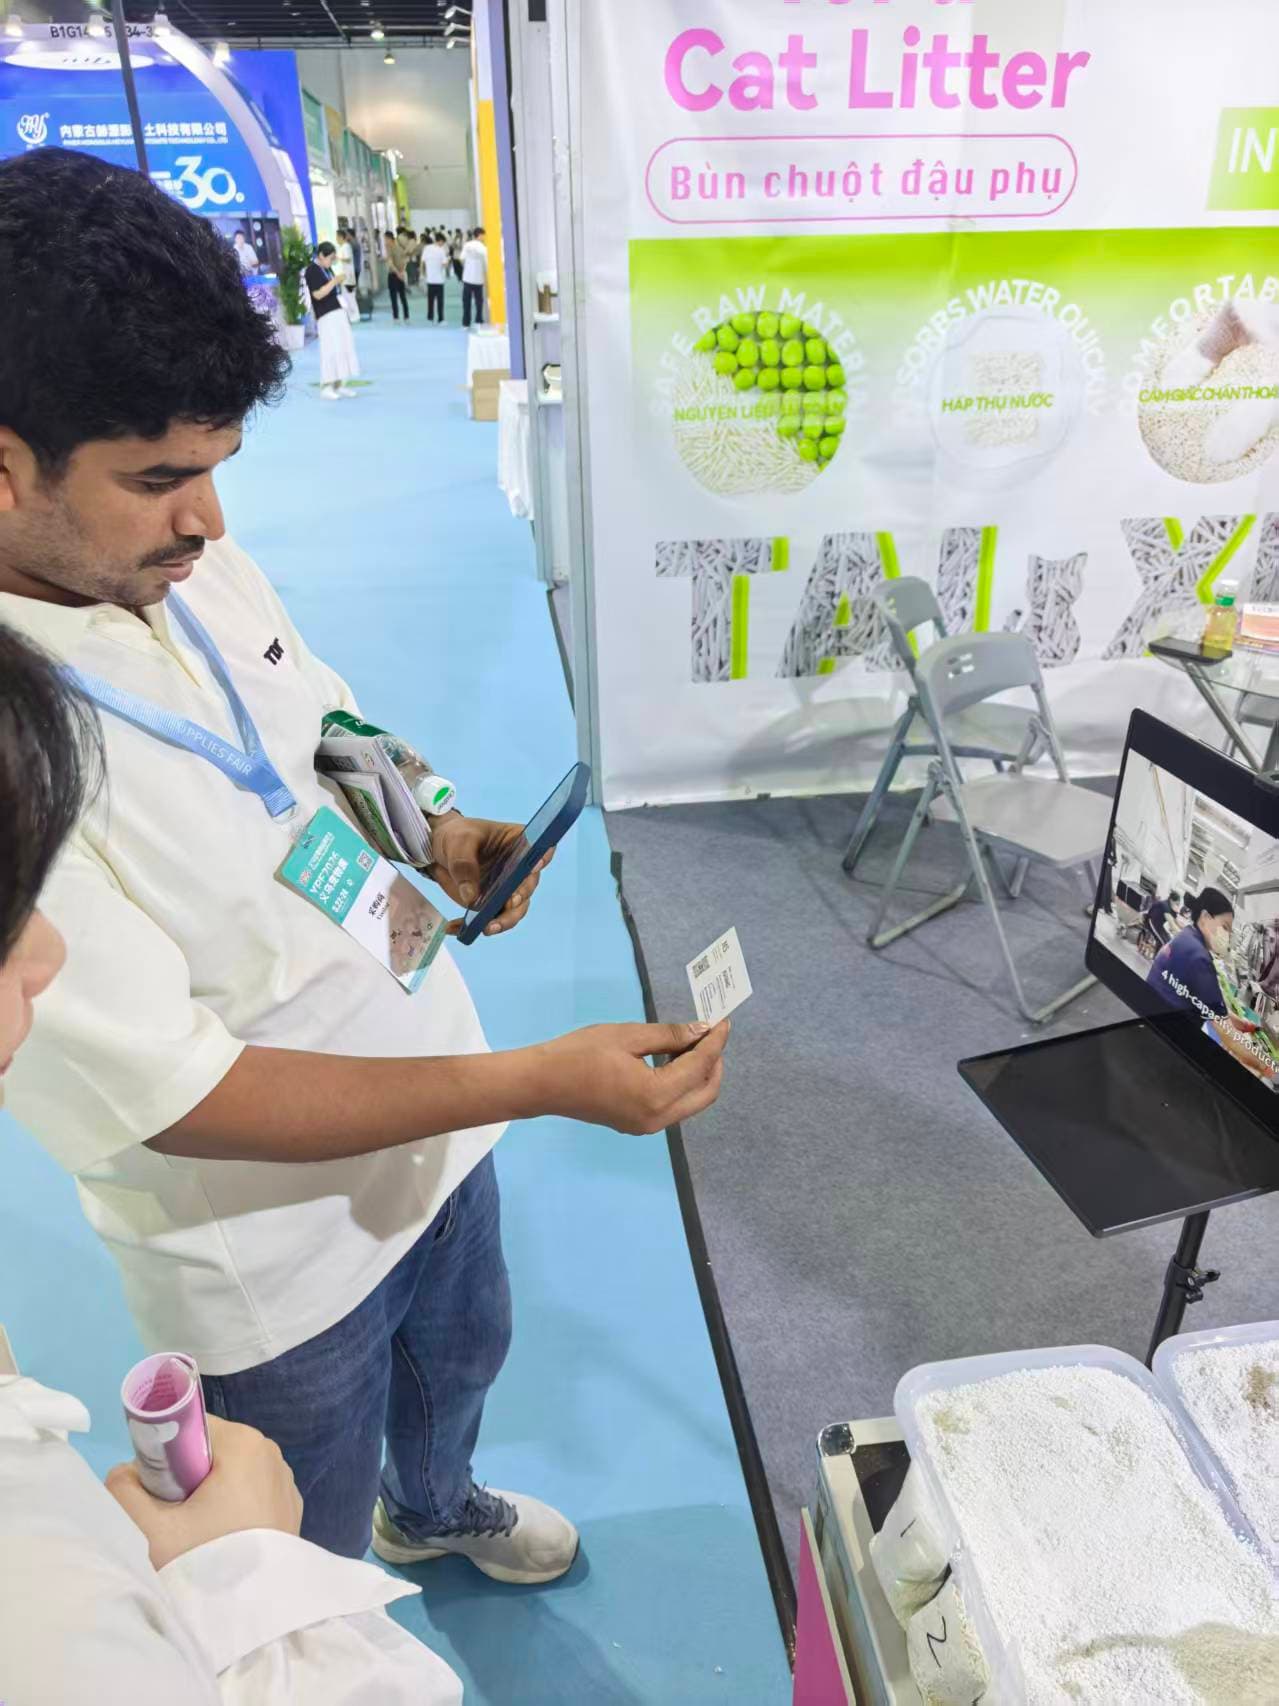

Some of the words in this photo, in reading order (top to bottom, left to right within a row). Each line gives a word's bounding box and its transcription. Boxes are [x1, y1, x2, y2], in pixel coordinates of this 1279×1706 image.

[664, 28, 818, 111] Cat
[848, 25, 1091, 109] Litter
[1228, 127, 1278, 173] IN
[672, 161, 745, 200] Bùn
[764, 161, 883, 202] chuột
[902, 159, 973, 201] đậu
[990, 162, 1061, 201] phụ
[691, 284, 766, 332] RAW
[966, 279, 1060, 317] WATER
[226, 753, 252, 775] FAIR
[1161, 969, 1169, 981] 4
[1168, 974, 1232, 1035] high-capacity
